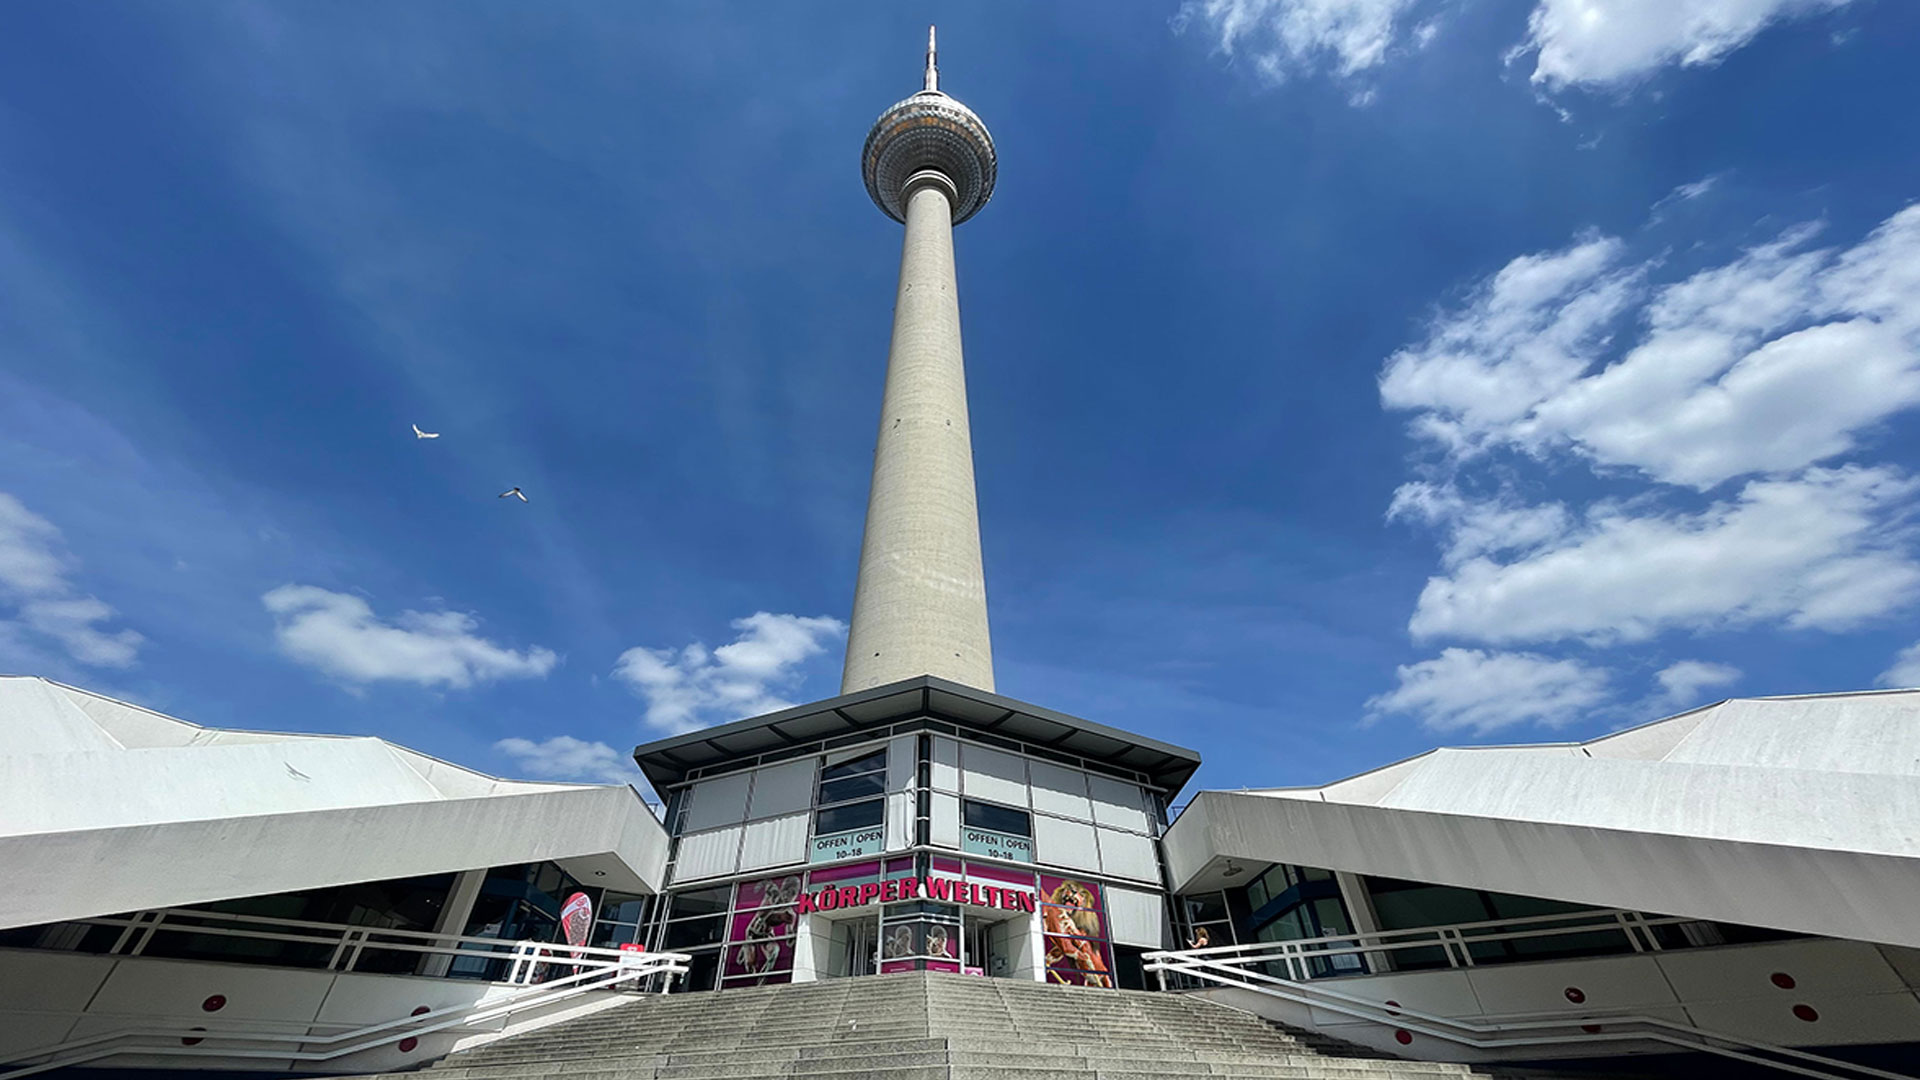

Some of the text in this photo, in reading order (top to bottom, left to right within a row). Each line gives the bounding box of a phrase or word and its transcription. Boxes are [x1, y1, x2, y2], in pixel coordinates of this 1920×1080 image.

[817, 831, 884, 850] OFFEN OPEN
[967, 832, 1031, 851] OFFEN OPEN
